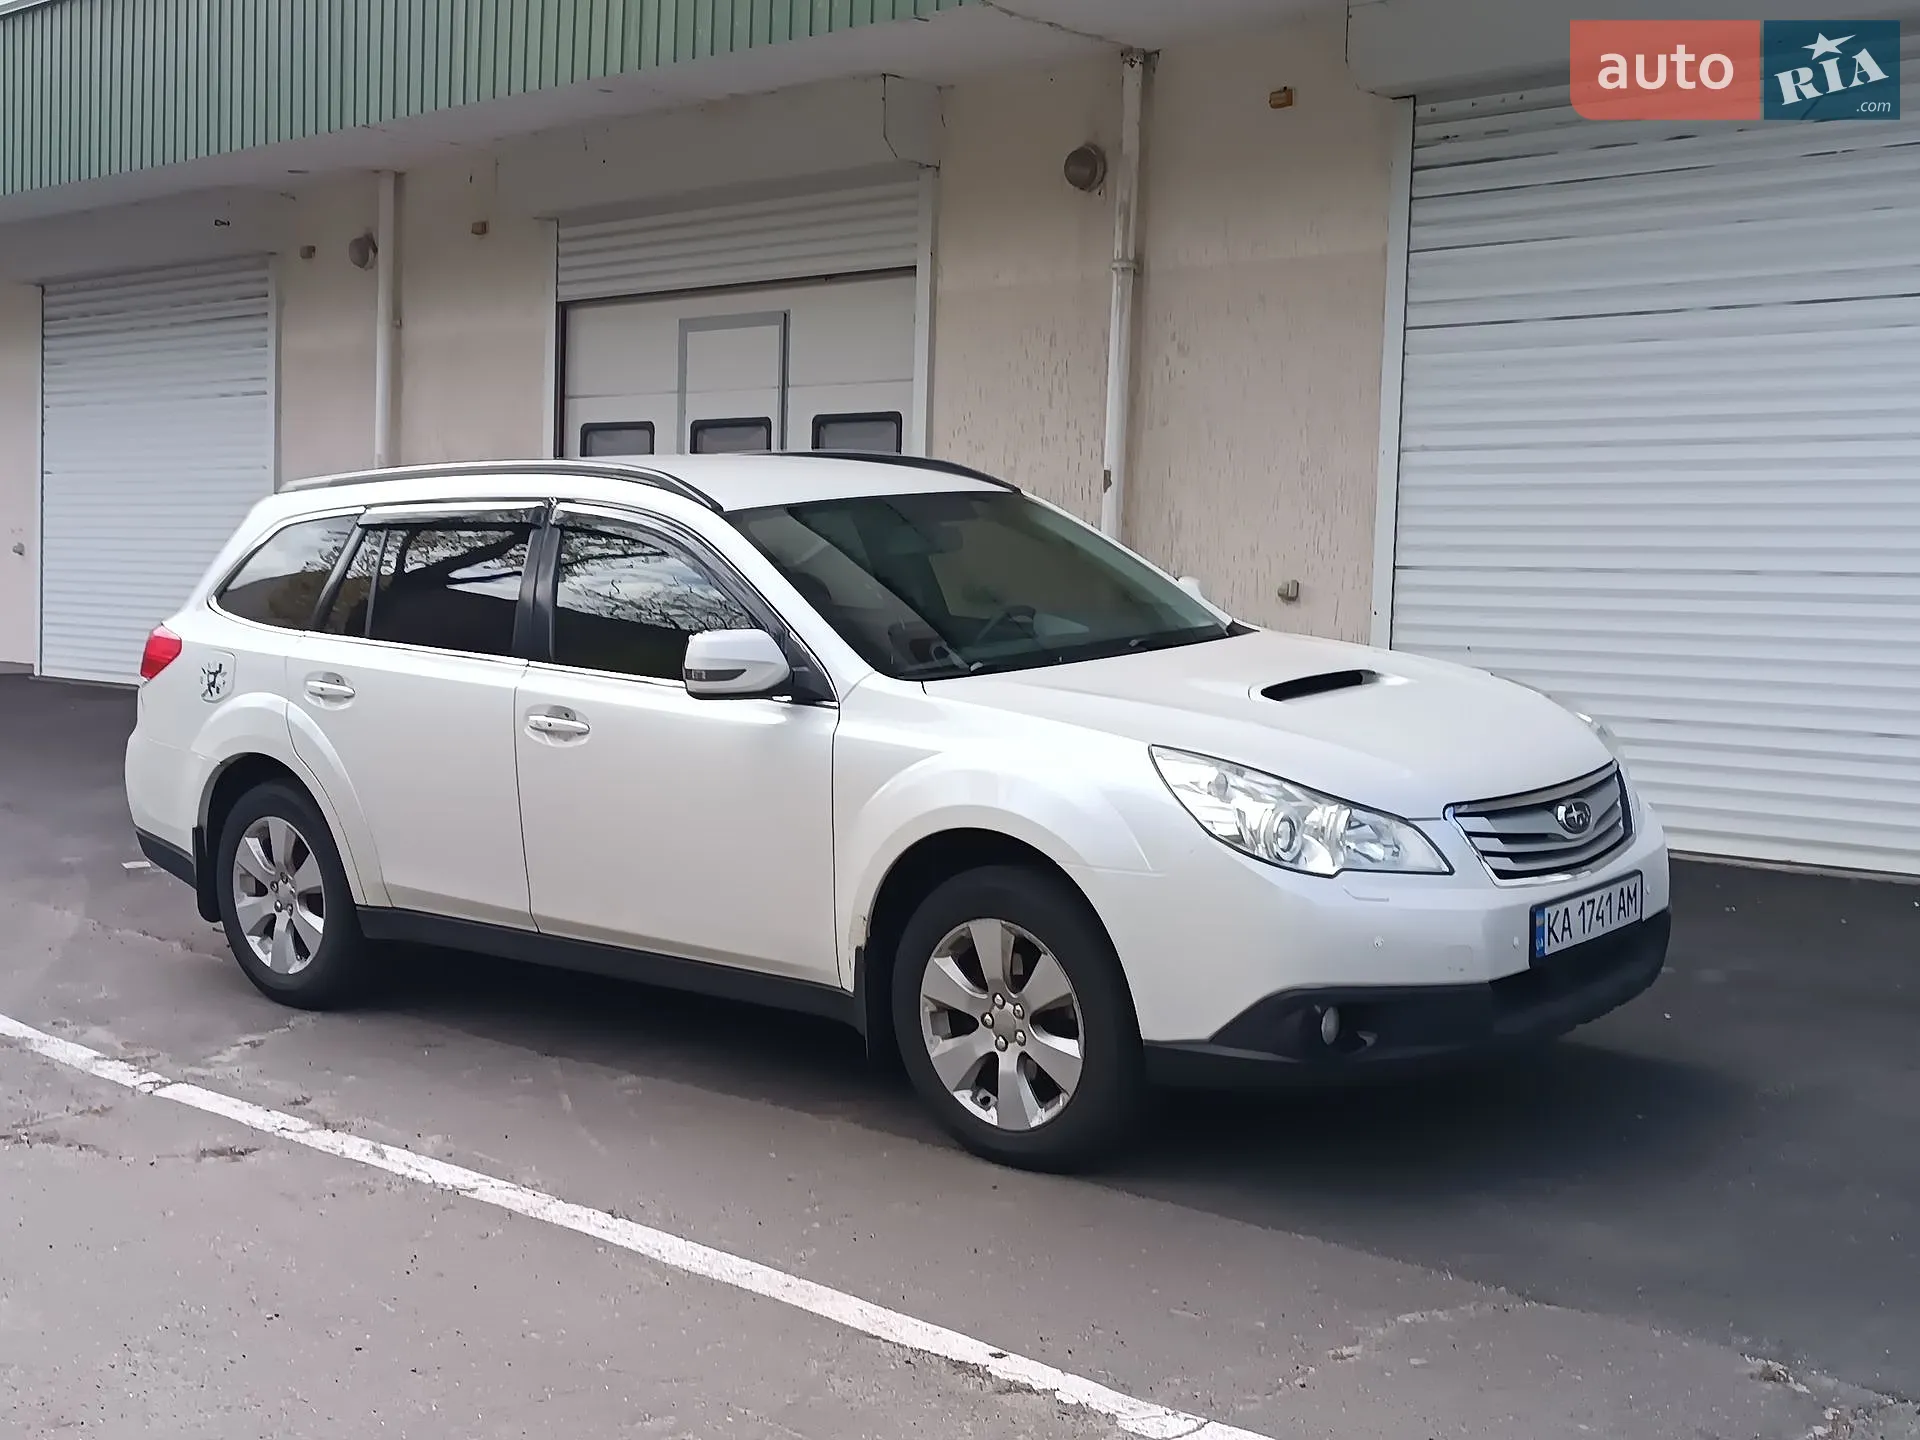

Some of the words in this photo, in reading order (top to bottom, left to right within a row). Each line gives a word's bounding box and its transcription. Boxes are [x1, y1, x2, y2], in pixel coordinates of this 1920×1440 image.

[1547, 907, 1573, 946] KA
[1578, 892, 1613, 934] 1741
[1617, 882, 1638, 921] AM
